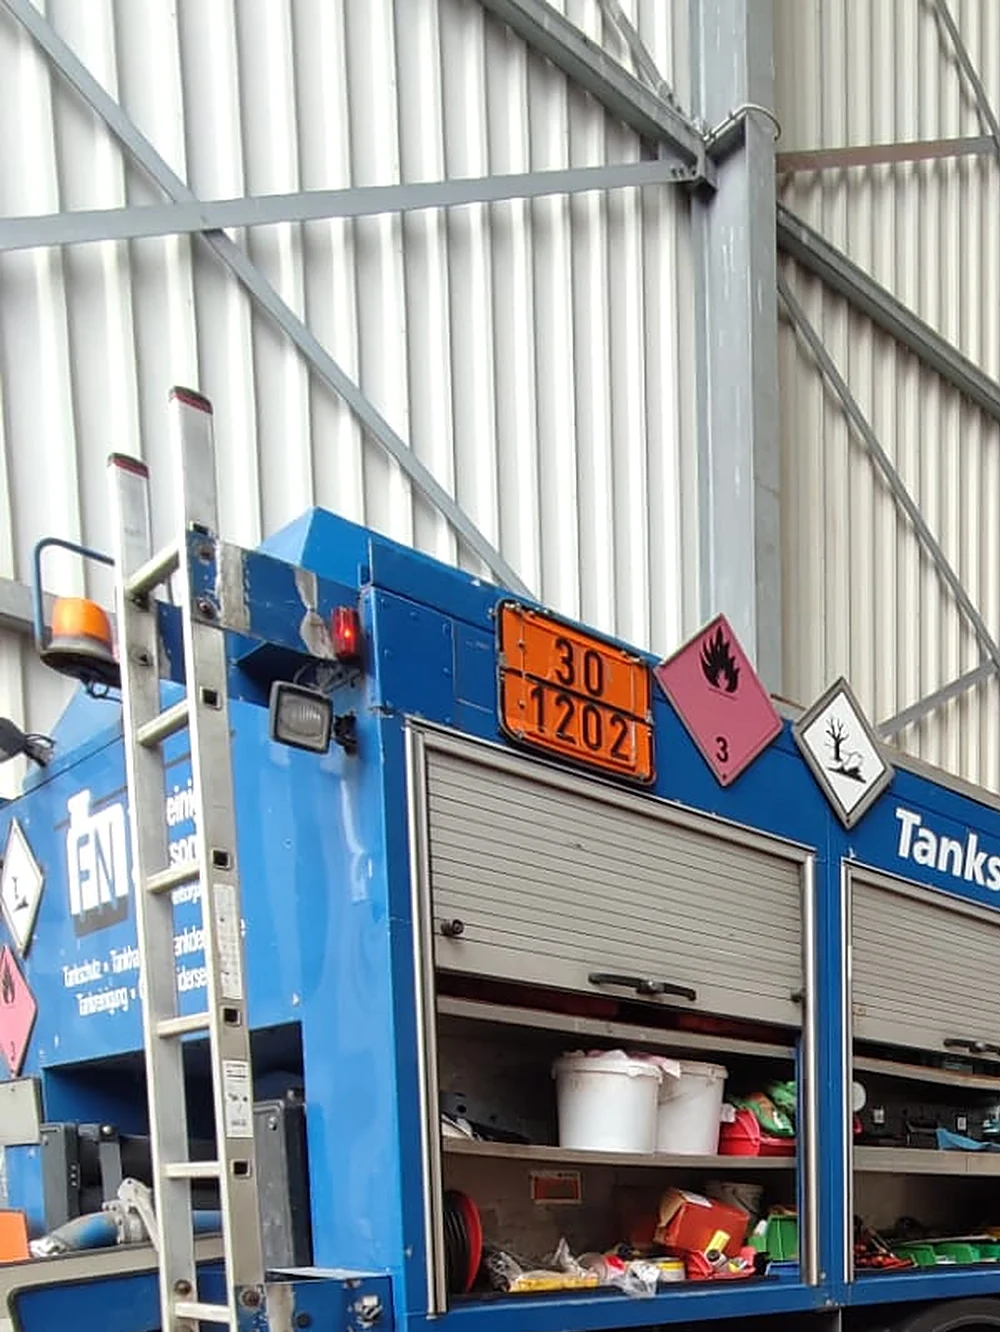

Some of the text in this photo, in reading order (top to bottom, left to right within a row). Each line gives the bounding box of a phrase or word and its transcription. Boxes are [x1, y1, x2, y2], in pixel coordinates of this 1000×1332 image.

[554, 638, 603, 697] 30
[529, 684, 631, 762] 1202
[716, 736, 729, 763] 3
